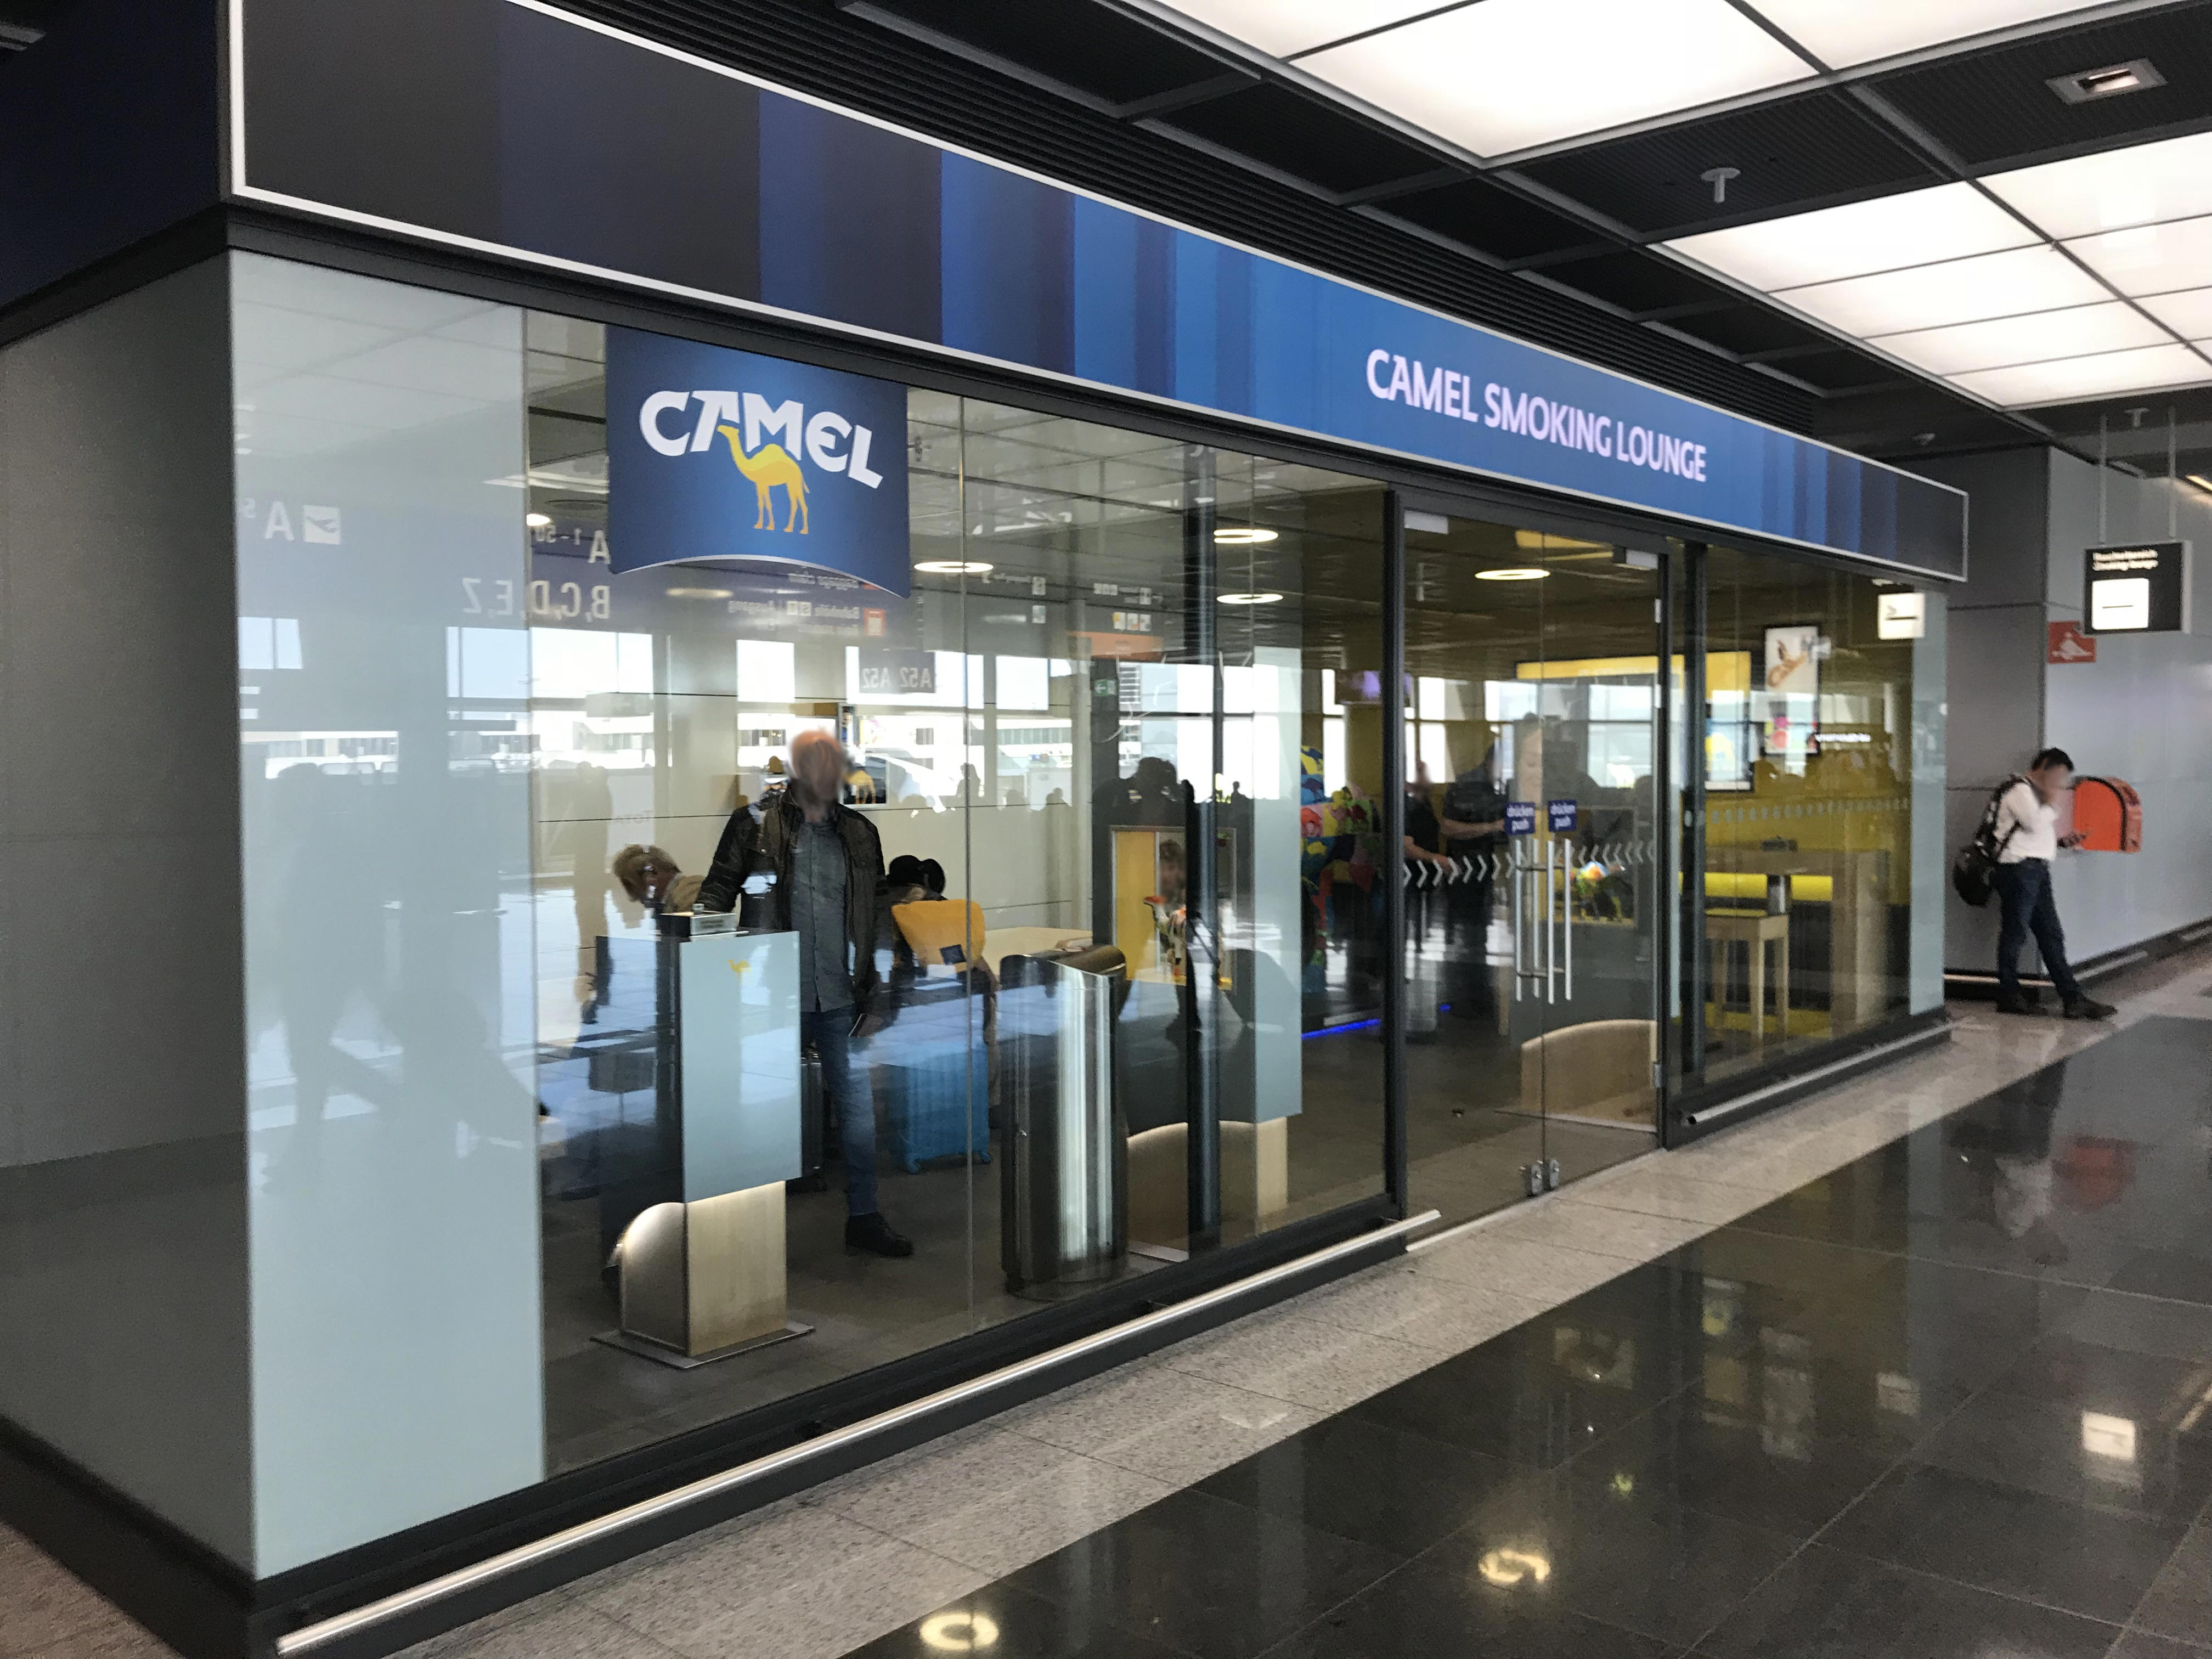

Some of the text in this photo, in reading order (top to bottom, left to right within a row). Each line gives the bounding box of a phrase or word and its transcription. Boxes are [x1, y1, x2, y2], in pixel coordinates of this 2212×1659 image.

[639, 390, 883, 489] CAMEL
[1366, 349, 1707, 483] CAMEL SMOKING LOUNGE
